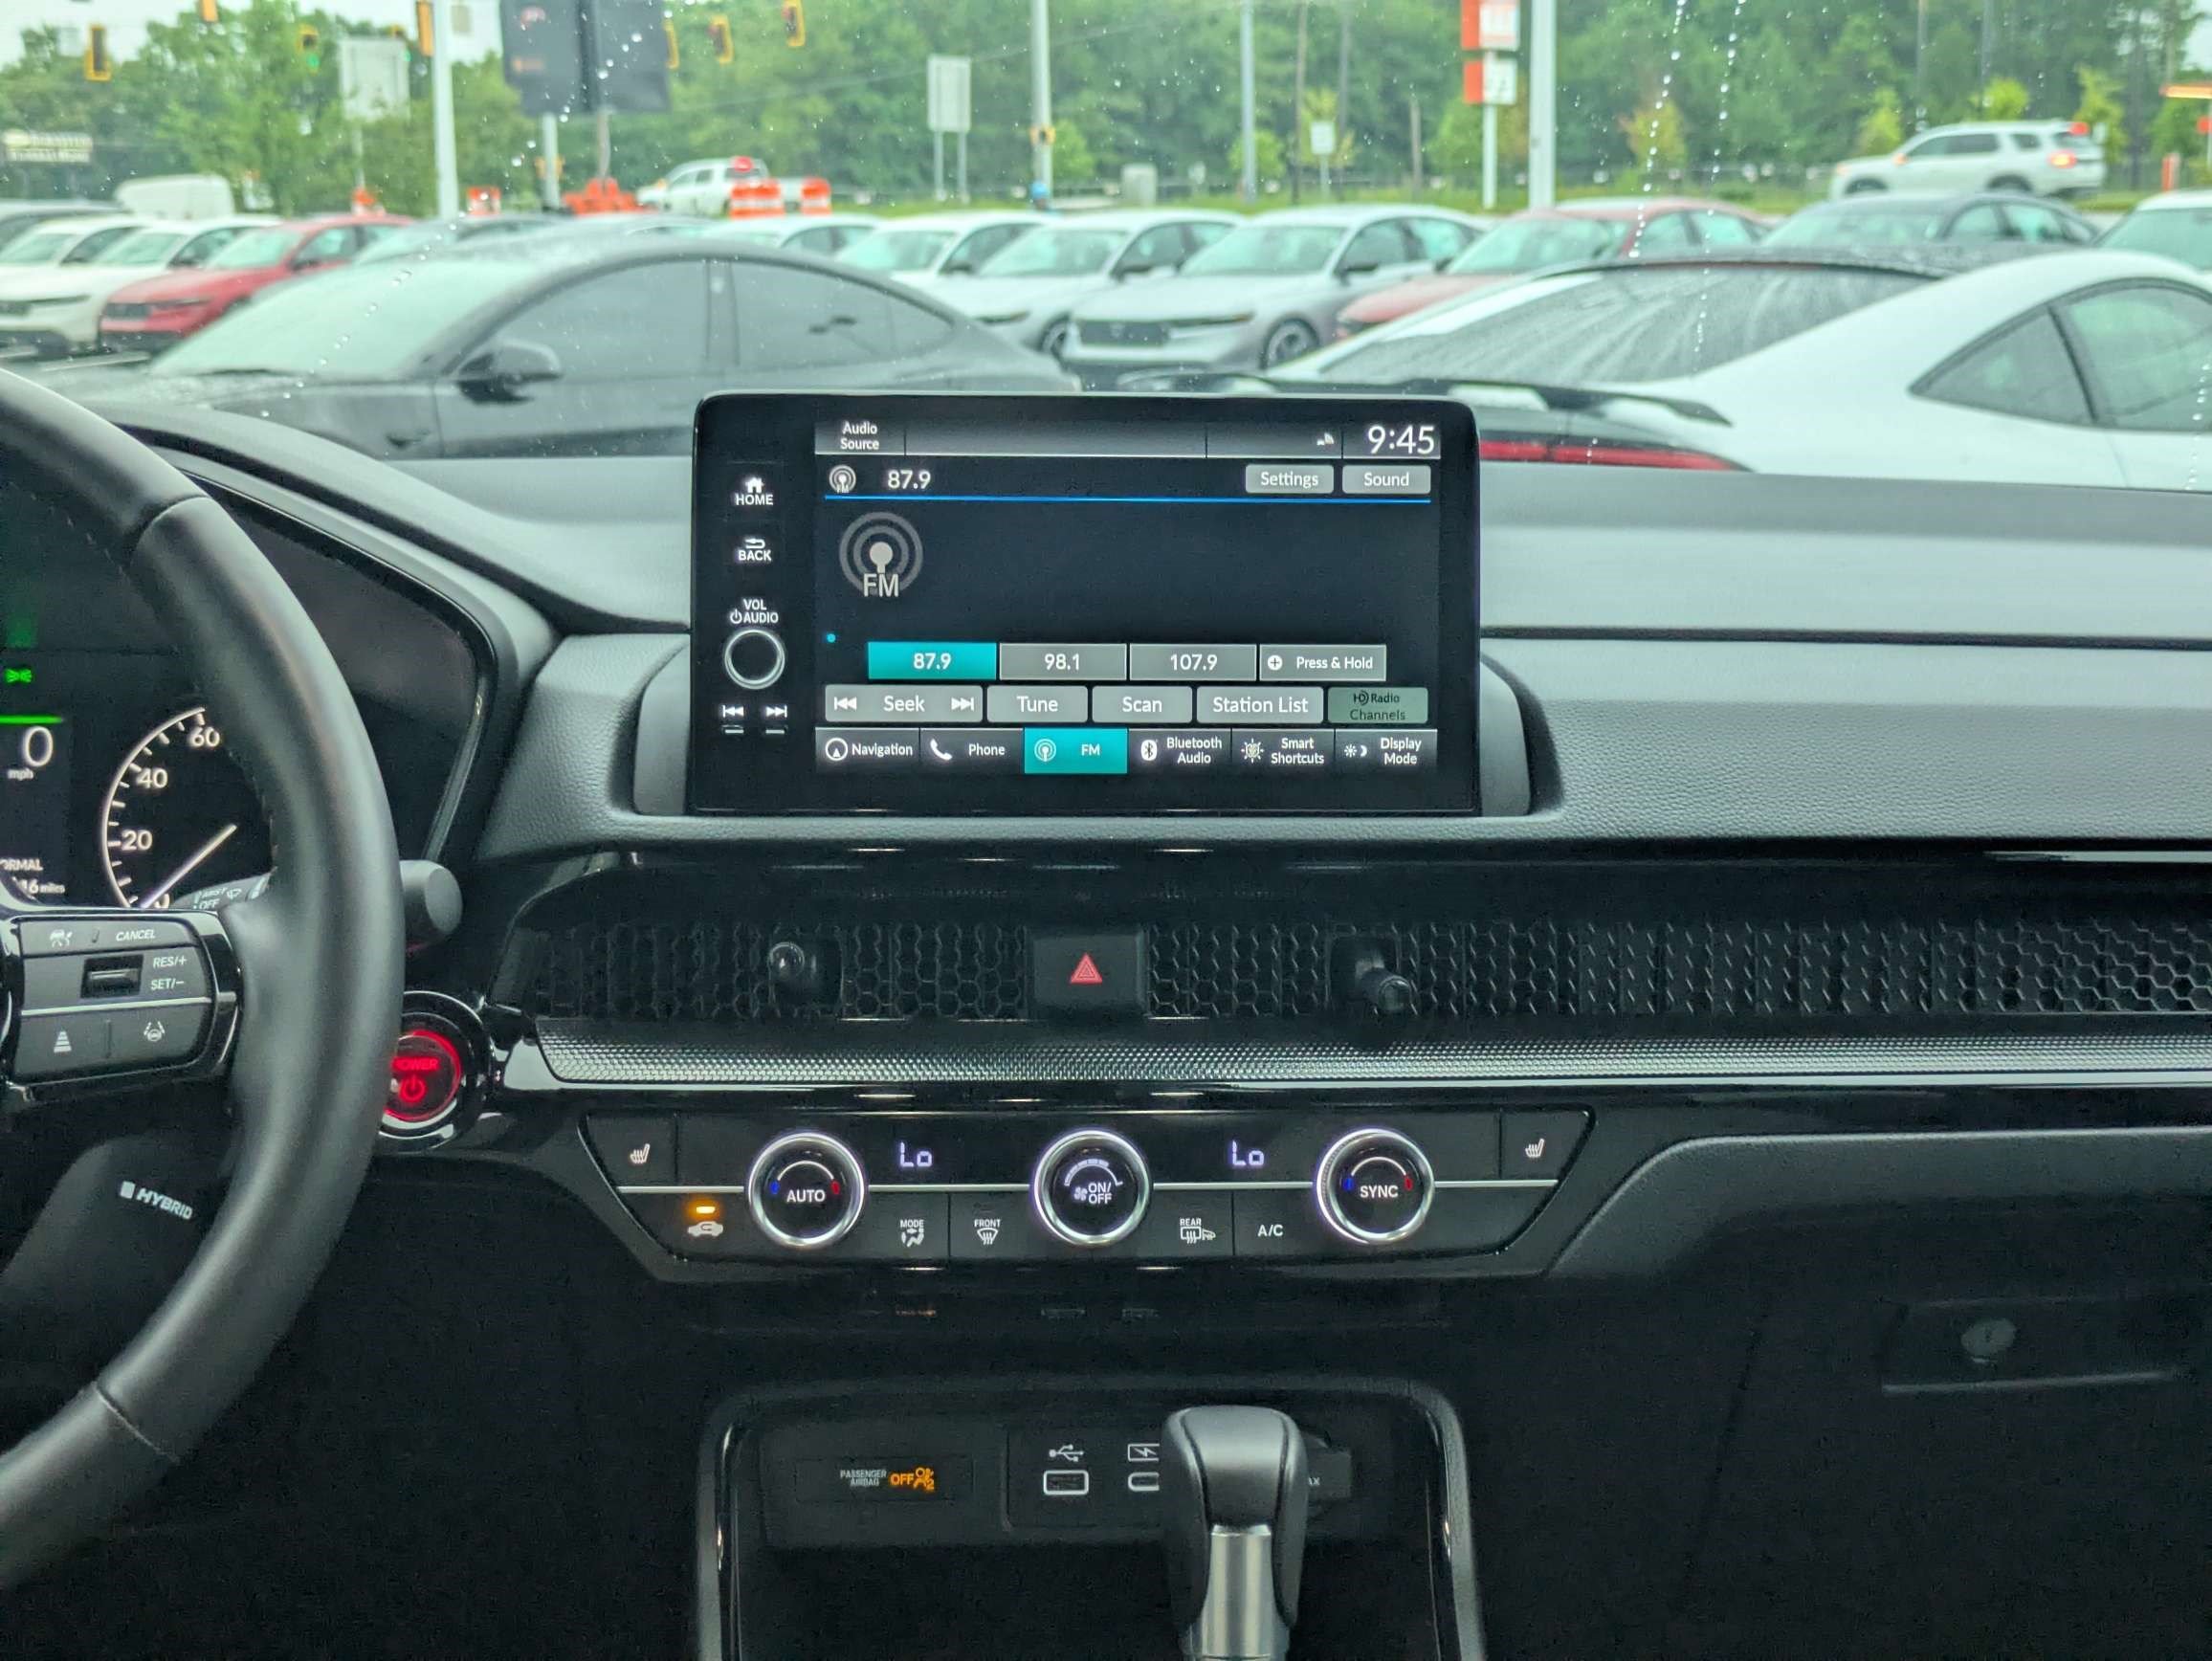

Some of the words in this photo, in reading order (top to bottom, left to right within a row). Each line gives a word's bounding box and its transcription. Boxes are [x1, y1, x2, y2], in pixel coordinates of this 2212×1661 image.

[842, 422, 877, 434] Audio
[841, 438, 879, 450] Source
[1368, 426, 1434, 454] 9:45
[888, 470, 930, 489] 87.9
[1261, 472, 1318, 488] Settings
[1364, 473, 1409, 486] Sound
[735, 494, 773, 506] HOME
[738, 549, 772, 562] BACK
[863, 574, 899, 597] FM
[743, 599, 766, 610] VOL
[743, 612, 779, 624] AUDIO
[914, 653, 951, 669] 87.9
[1045, 653, 1079, 670] 98.1
[1171, 654, 1217, 670] 107.9
[1297, 656, 1327, 668] Press
[1331, 657, 1340, 668] &
[1344, 656, 1372, 669] Hold
[884, 696, 924, 711] Seek
[1017, 697, 1058, 712] Tune
[1122, 697, 1161, 712] Scan
[1213, 697, 1272, 712] Station
[1279, 697, 1308, 712] List
[1371, 692, 1401, 704] Radio
[1349, 708, 1406, 720] Channels
[189, 727, 220, 746] 60
[1167, 737, 1222, 748] Bluetooth
[1282, 738, 1314, 748] Smart
[23, 726, 54, 766] 0
[852, 743, 913, 757] Navigation
[969, 743, 1005, 755] Phone
[1082, 744, 1099, 755] FM
[1381, 738, 1422, 751] Display
[1178, 752, 1210, 764] Audio
[1272, 752, 1324, 764] Shortcuts
[1384, 753, 1417, 764] Mode
[8, 768, 34, 781] mph
[136, 768, 168, 789] 40
[121, 830, 153, 851] 20
[116, 929, 155, 941] CANCEL
[153, 956, 187, 967] RES/+
[1089, 1182, 1111, 1193] ON/
[1360, 1185, 1398, 1198] SYNC
[786, 1189, 825, 1202] AUTO
[1089, 1193, 1112, 1205] OFF
[136, 1187, 193, 1220] HYBRID
[900, 1219, 924, 1229] MODE
[974, 1219, 1001, 1229] FRONT
[1258, 1225, 1283, 1236] A/C
[840, 1470, 886, 1478] PASSENGER
[890, 1473, 915, 1486] OFF
